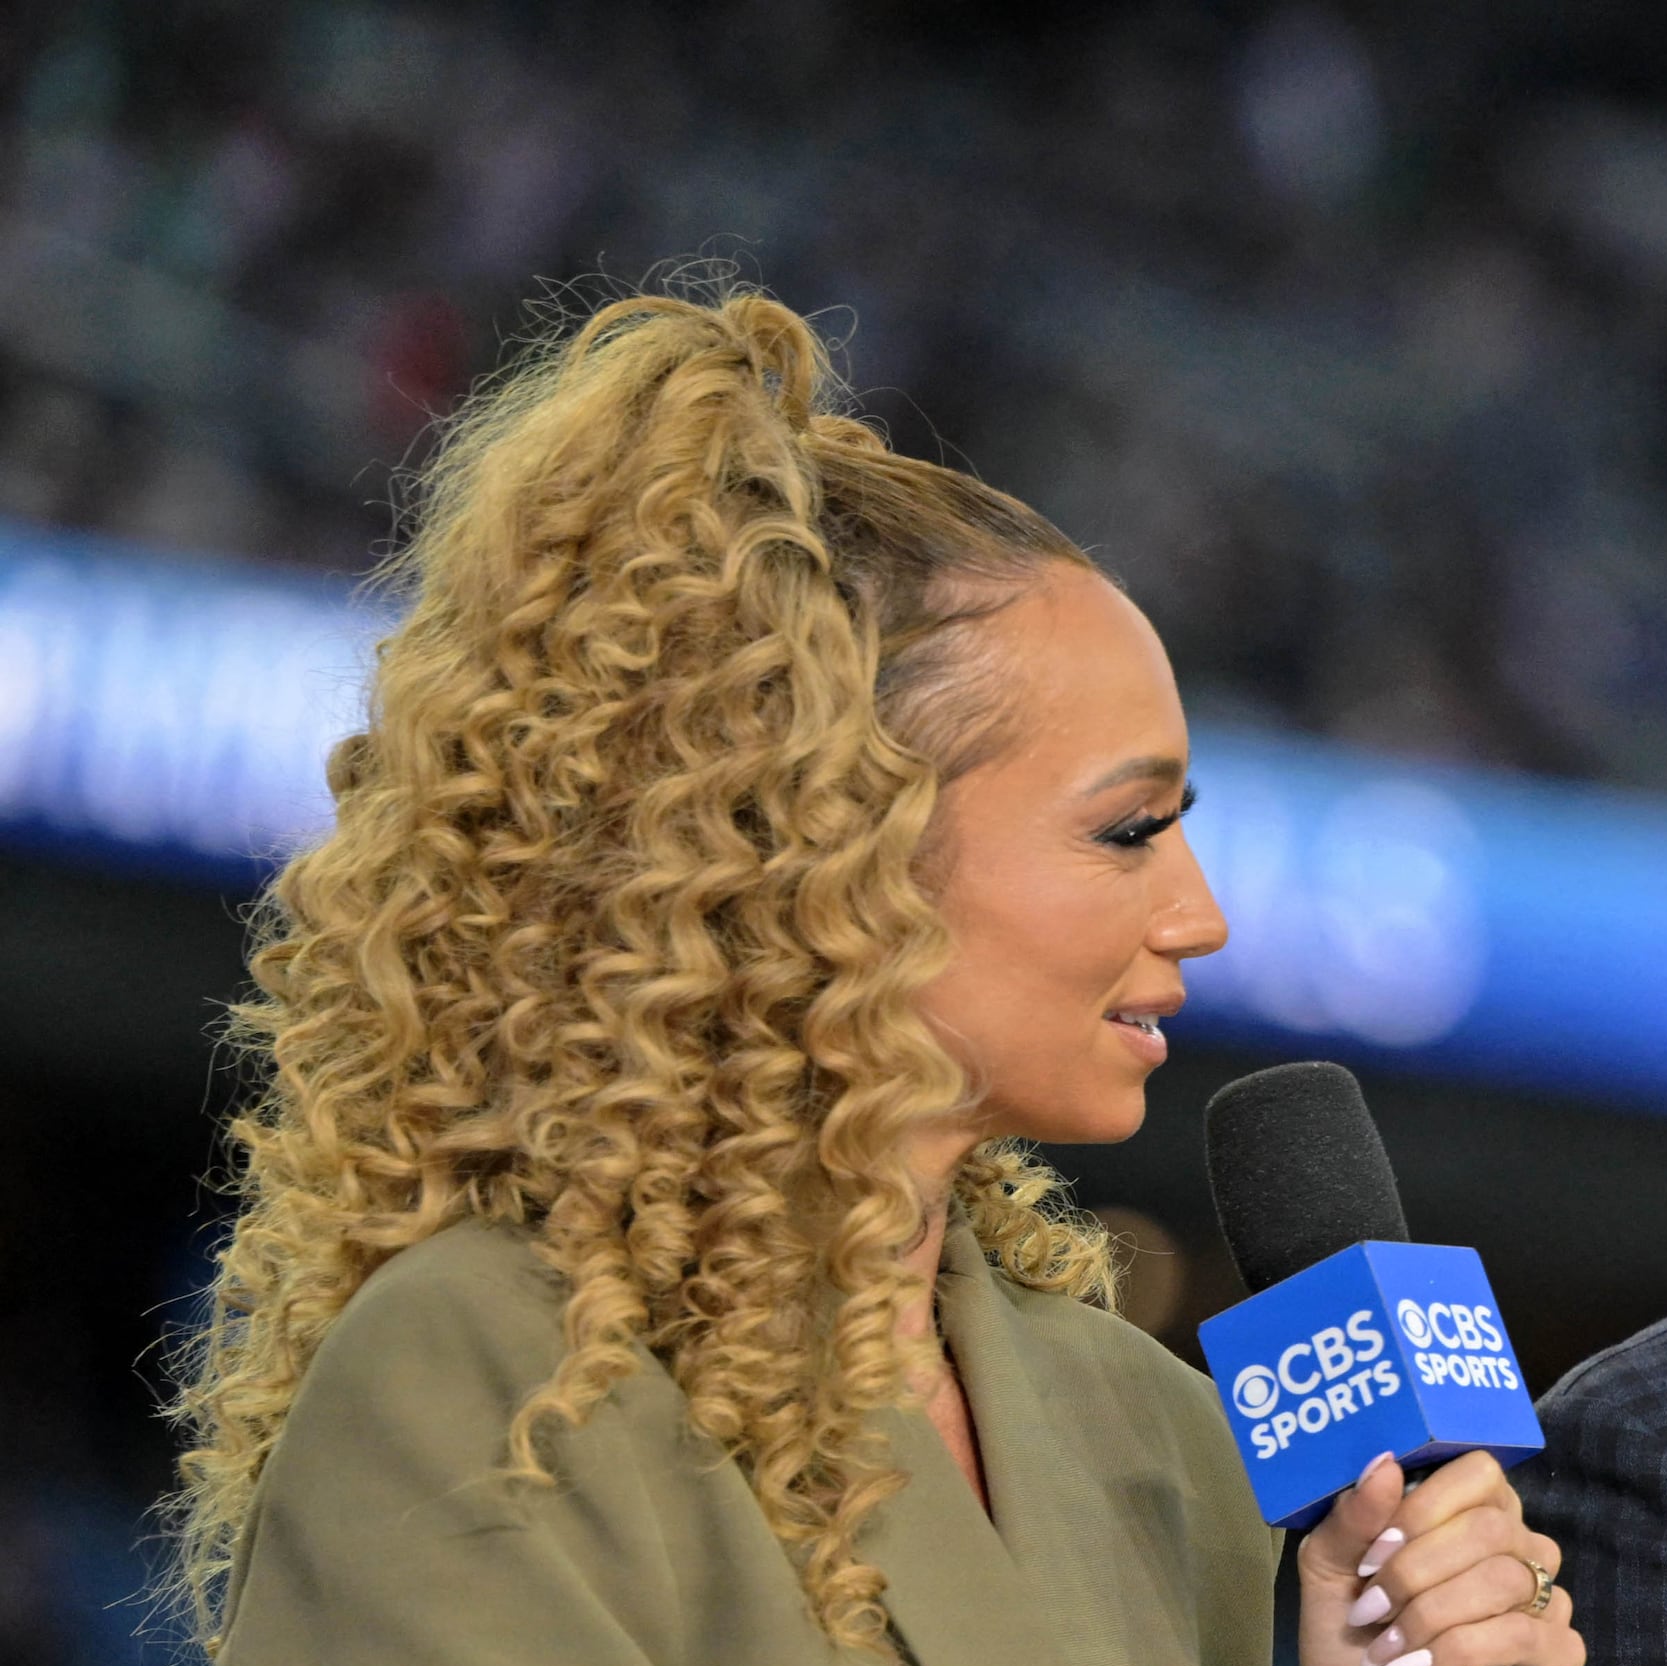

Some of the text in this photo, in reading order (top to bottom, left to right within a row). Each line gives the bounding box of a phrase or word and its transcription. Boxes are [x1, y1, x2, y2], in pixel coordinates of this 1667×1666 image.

[1278, 1310, 1385, 1395] CBS
[1428, 1302, 1503, 1352] CBS
[1414, 1352, 1518, 1390] SPORTS
[1250, 1360, 1400, 1460] SPORTS
